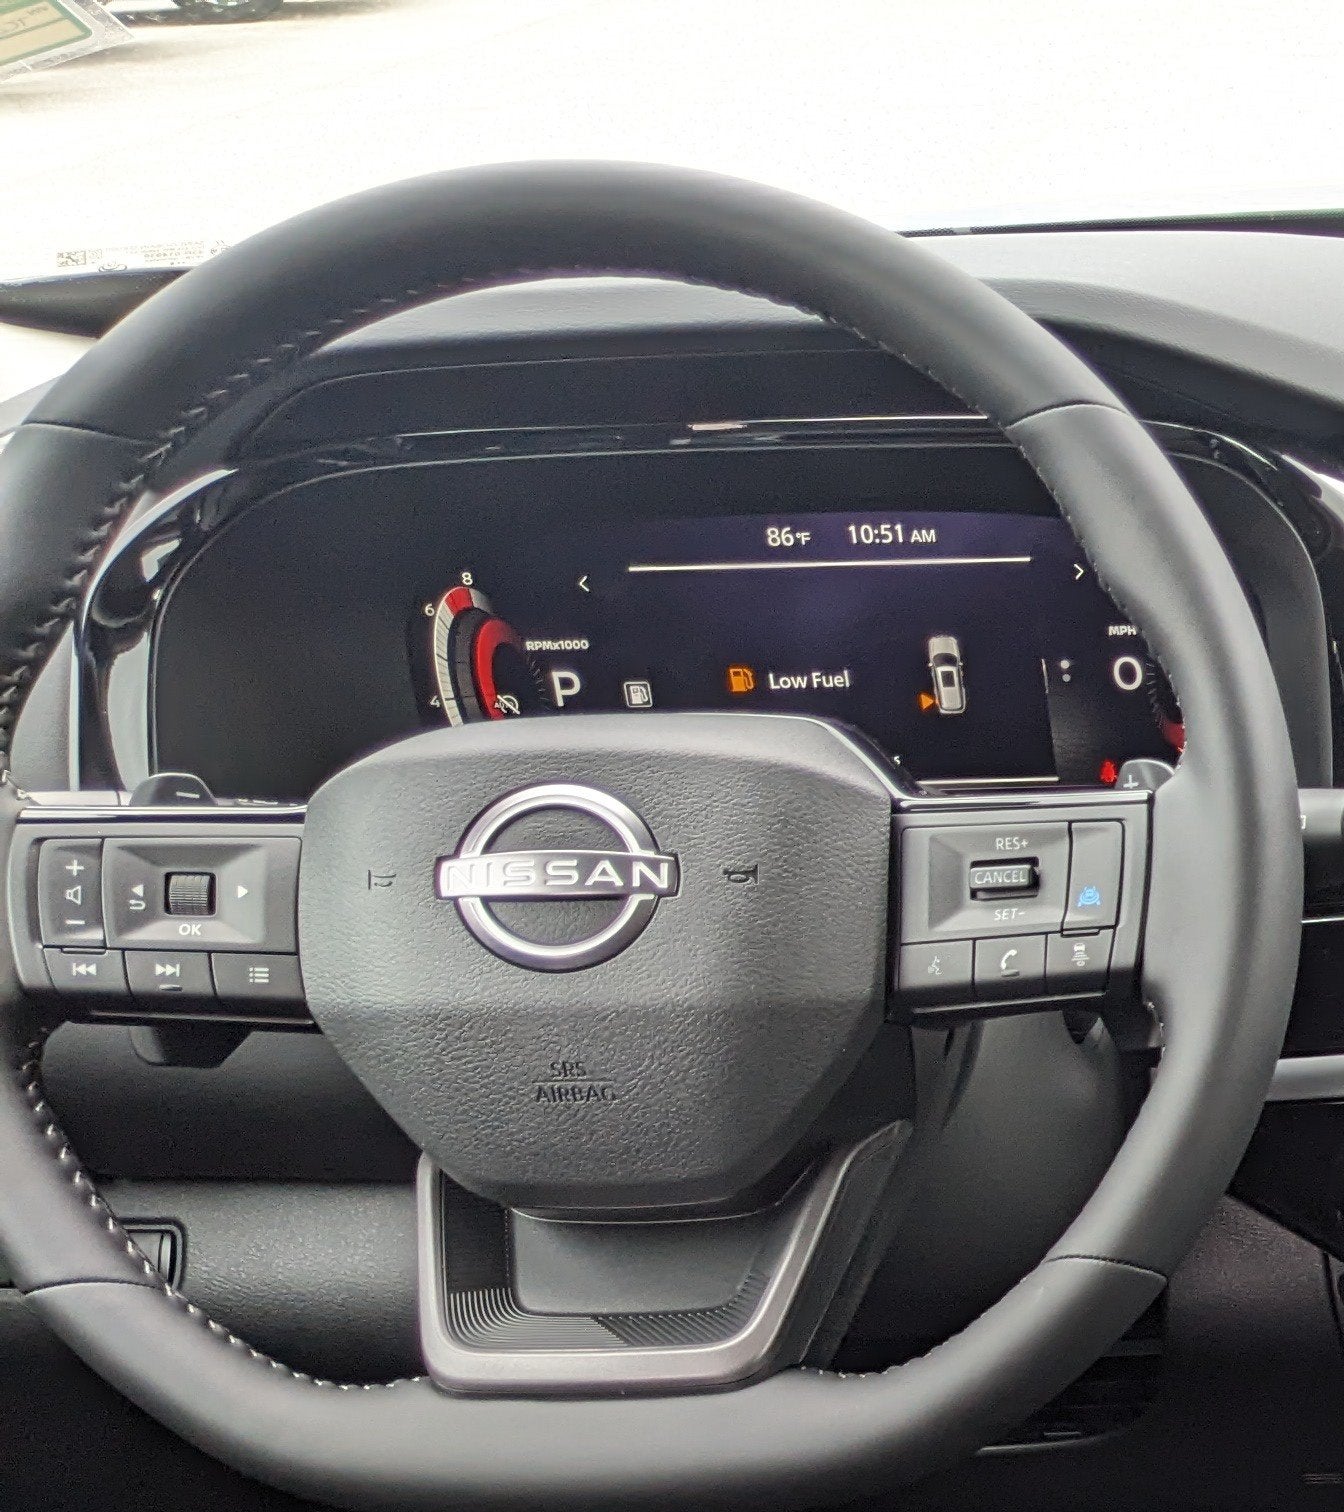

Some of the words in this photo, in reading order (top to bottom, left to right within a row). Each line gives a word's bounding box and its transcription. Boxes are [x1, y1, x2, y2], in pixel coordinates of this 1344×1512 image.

[848, 523, 903, 544] 10:51
[910, 529, 936, 543] AM
[461, 571, 473, 586] 8
[424, 603, 435, 617] 6
[1108, 625, 1137, 636] MPH
[525, 639, 589, 652] RPMx1000
[768, 672, 807, 690] Low
[812, 669, 850, 689] Fuel
[552, 671, 581, 707] P
[430, 694, 441, 708] 4
[995, 837, 1029, 850] RES+
[446, 858, 670, 891] NISSAN
[974, 869, 1028, 886] CANCEL
[178, 923, 202, 937] OK
[549, 1060, 587, 1078] SRS
[535, 1084, 617, 1103] AIRBAG
